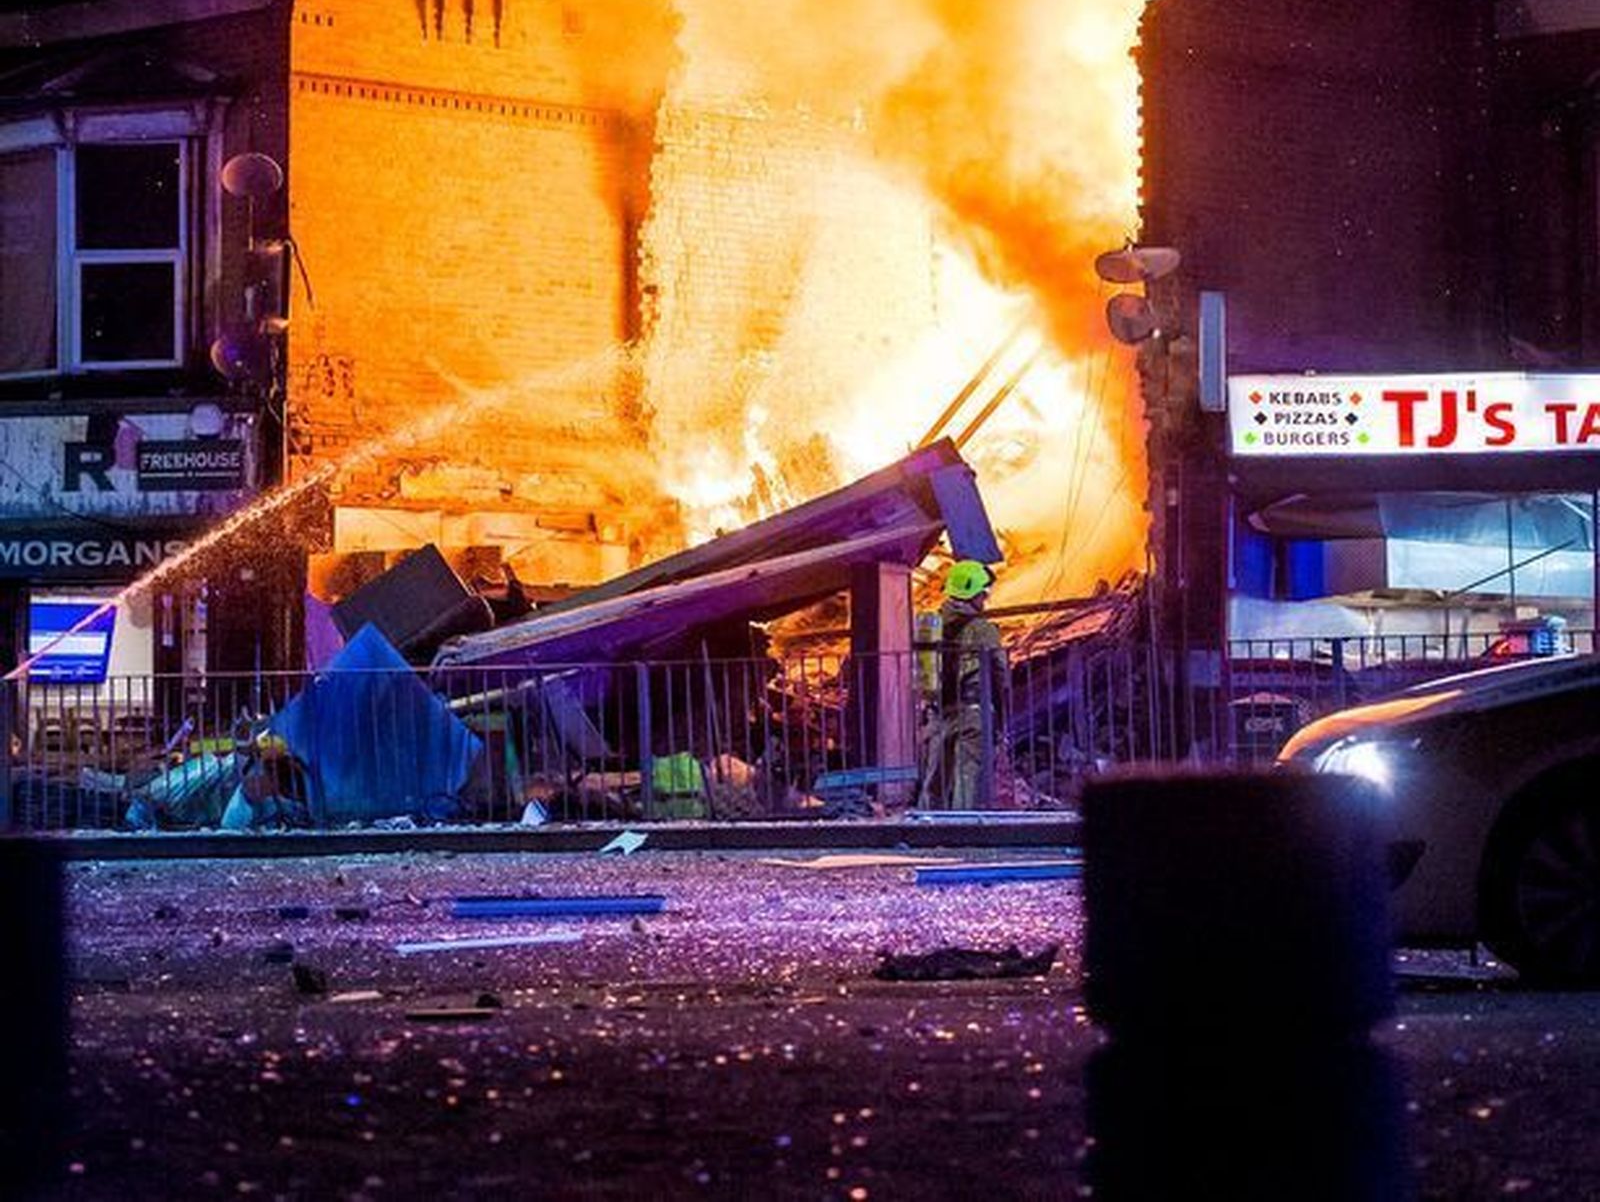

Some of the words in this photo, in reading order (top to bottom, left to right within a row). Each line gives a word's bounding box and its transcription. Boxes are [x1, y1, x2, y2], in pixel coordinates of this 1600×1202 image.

[1268, 391, 1343, 406] KEBABS
[1274, 411, 1338, 425] PIZZAS
[1545, 403, 1600, 444] TA
[1263, 431, 1350, 446] BURGERS
[140, 452, 240, 470] FREEHOUSE
